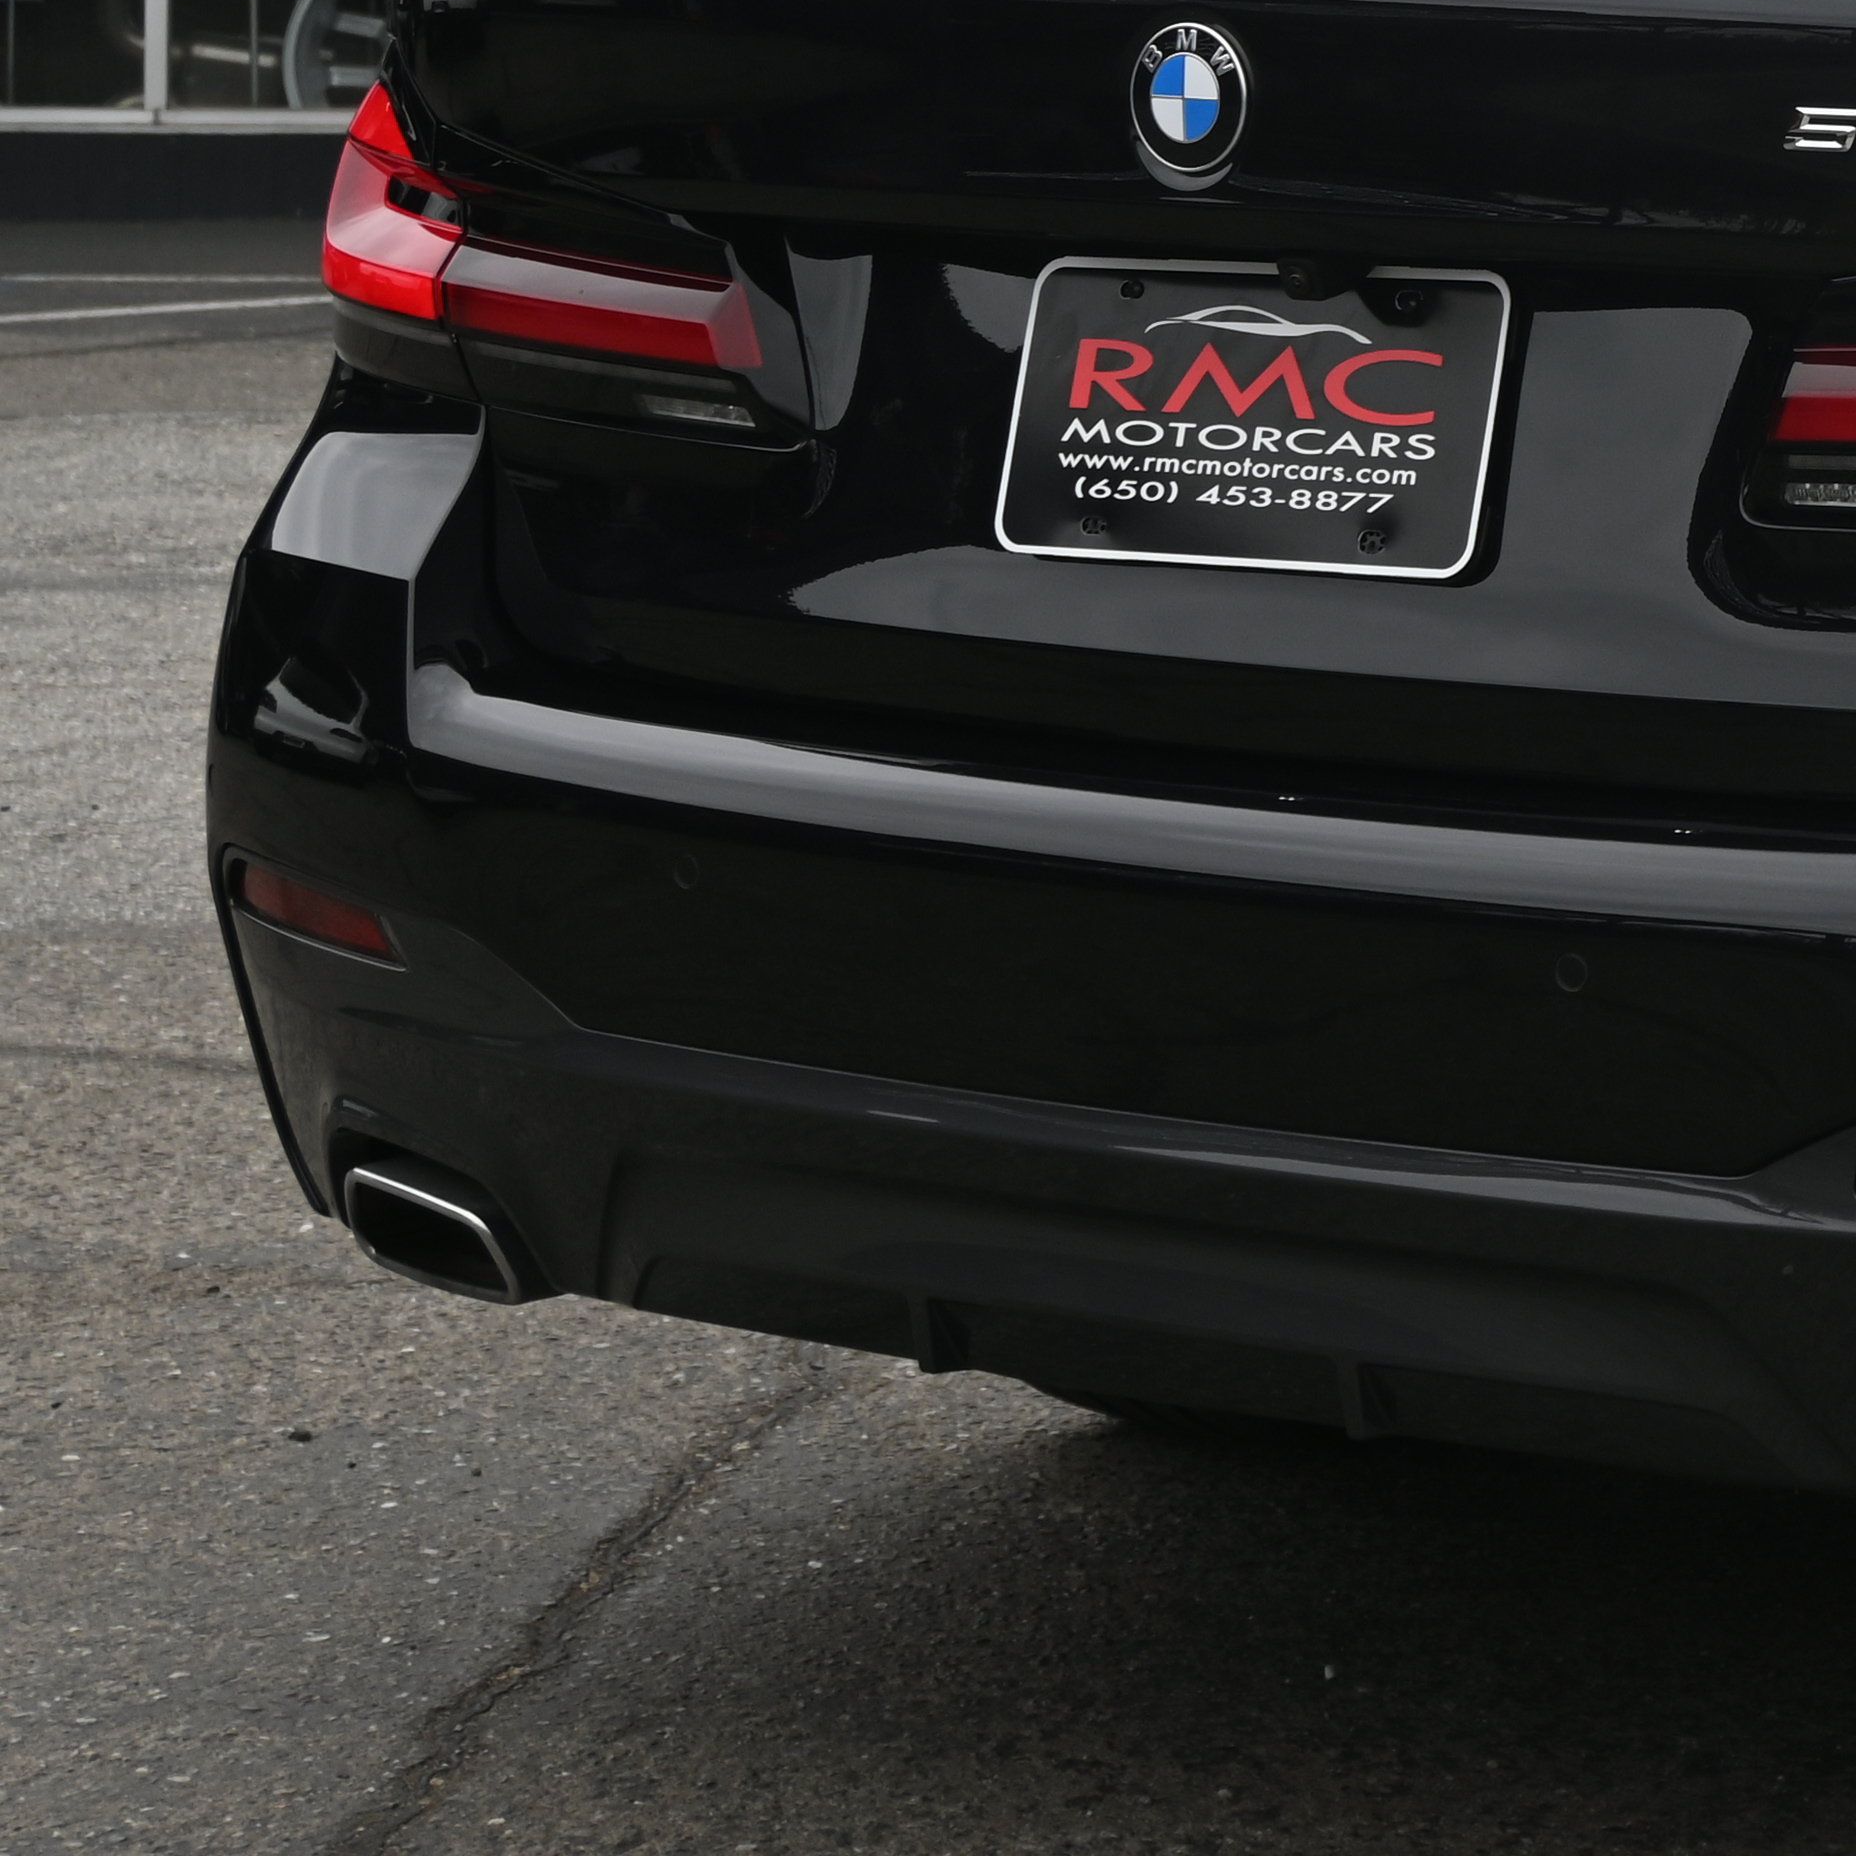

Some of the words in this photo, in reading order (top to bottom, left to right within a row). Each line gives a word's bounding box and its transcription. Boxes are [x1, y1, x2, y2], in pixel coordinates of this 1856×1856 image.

[1141, 28, 1234, 75] BMW
[1068, 338, 1444, 426] RMC
[1060, 417, 1436, 461] MOTORCARS
[1058, 452, 1417, 486] www.rmcmotorcars.com
[1074, 476, 1179, 504] (650)
[1196, 484, 1395, 514] 453-8877
